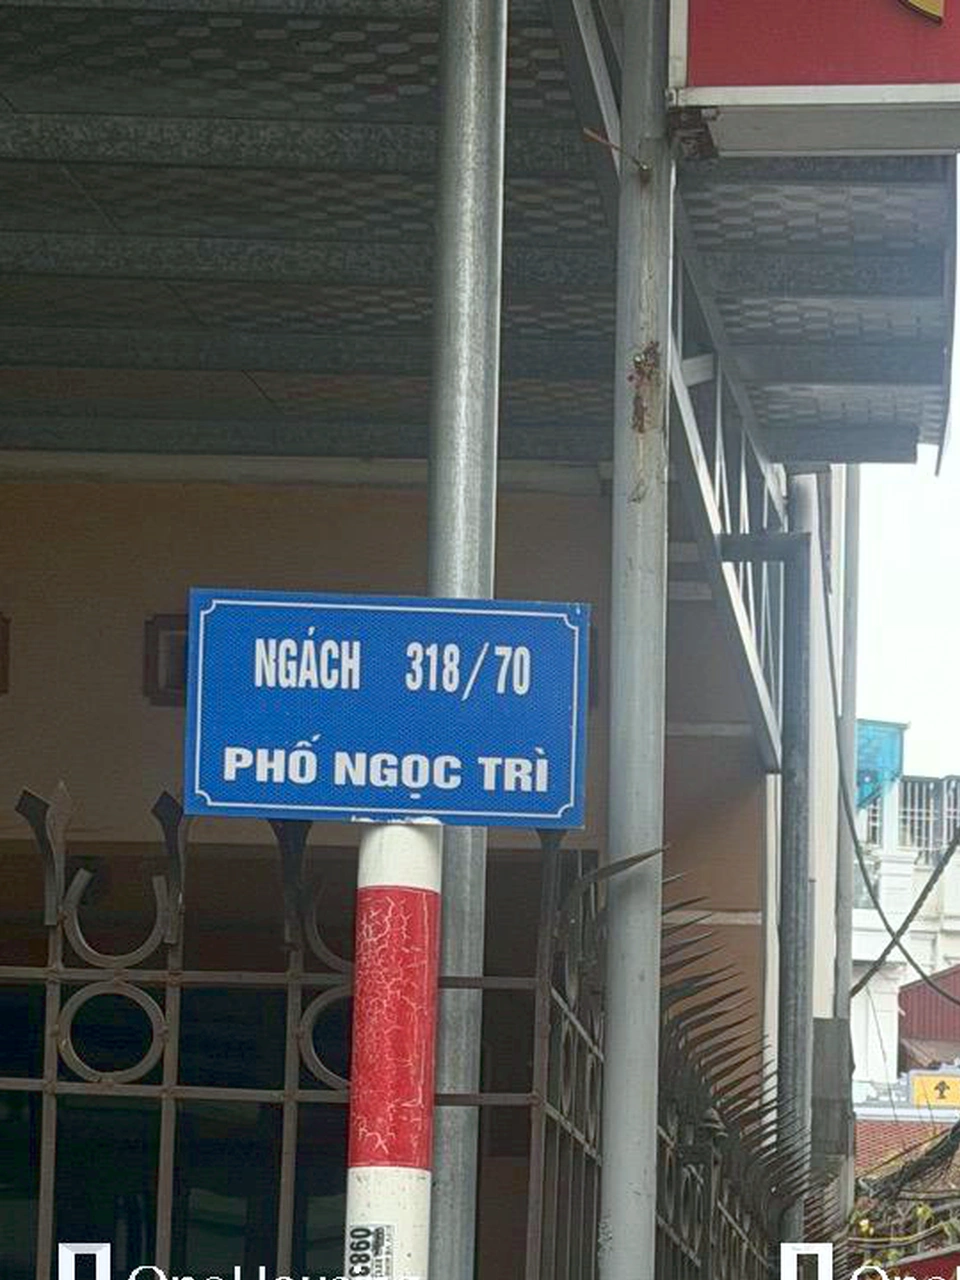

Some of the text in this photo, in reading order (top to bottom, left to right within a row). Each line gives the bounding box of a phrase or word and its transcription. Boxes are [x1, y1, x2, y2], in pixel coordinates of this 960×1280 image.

[255, 626, 531, 701] NGÁCH 318/70
[223, 733, 549, 800] PHỐ NGỌC TRÌ
